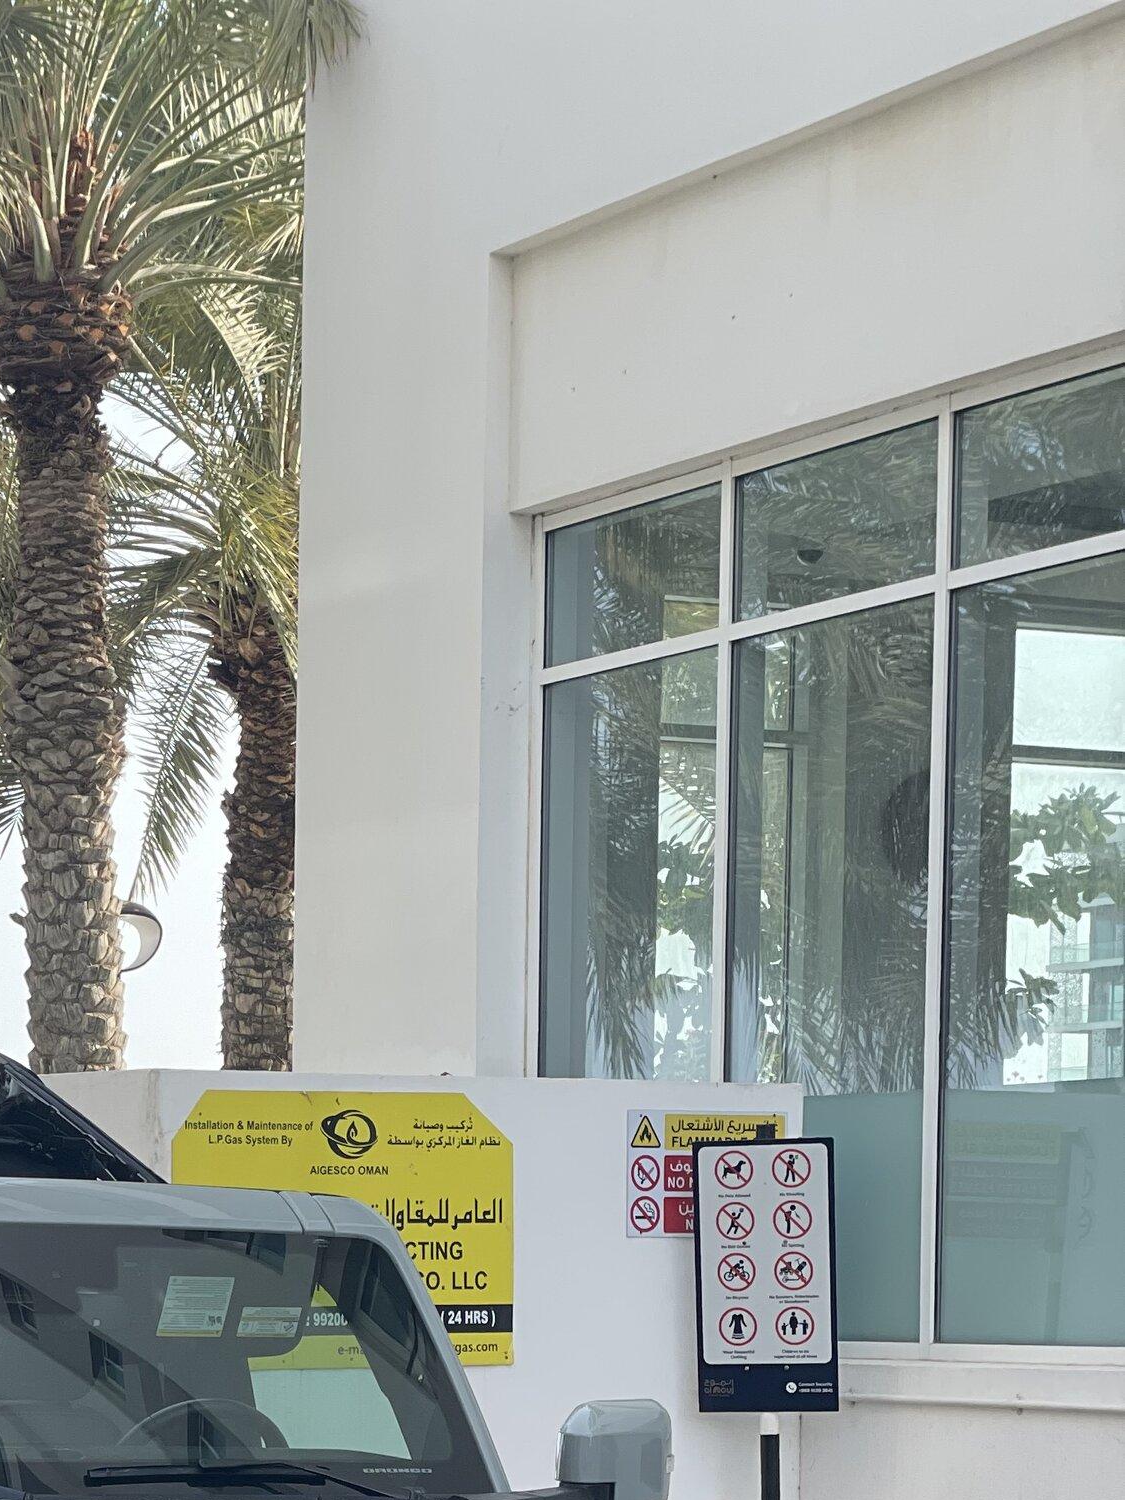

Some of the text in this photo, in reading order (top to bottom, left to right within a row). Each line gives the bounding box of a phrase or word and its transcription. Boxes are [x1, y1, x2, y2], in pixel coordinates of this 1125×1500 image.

[184, 1120, 314, 1131] Installation & Maintenance of
[413, 1118, 444, 1133] وصيانة
[208, 1134, 293, 1147] L.P.Gas System By
[387, 1134, 424, 1149] بواسطة
[456, 1136, 477, 1149] الغاز
[479, 1136, 501, 1149] نظام
[310, 1165, 389, 1176] AIGESCO OMAN
[667, 1176, 685, 1189] NO
[419, 1271, 488, 1290] O. LLC
[447, 1311, 462, 1325] 24
[465, 1311, 489, 1325] HRS
[452, 1342, 498, 1355] gas.com
